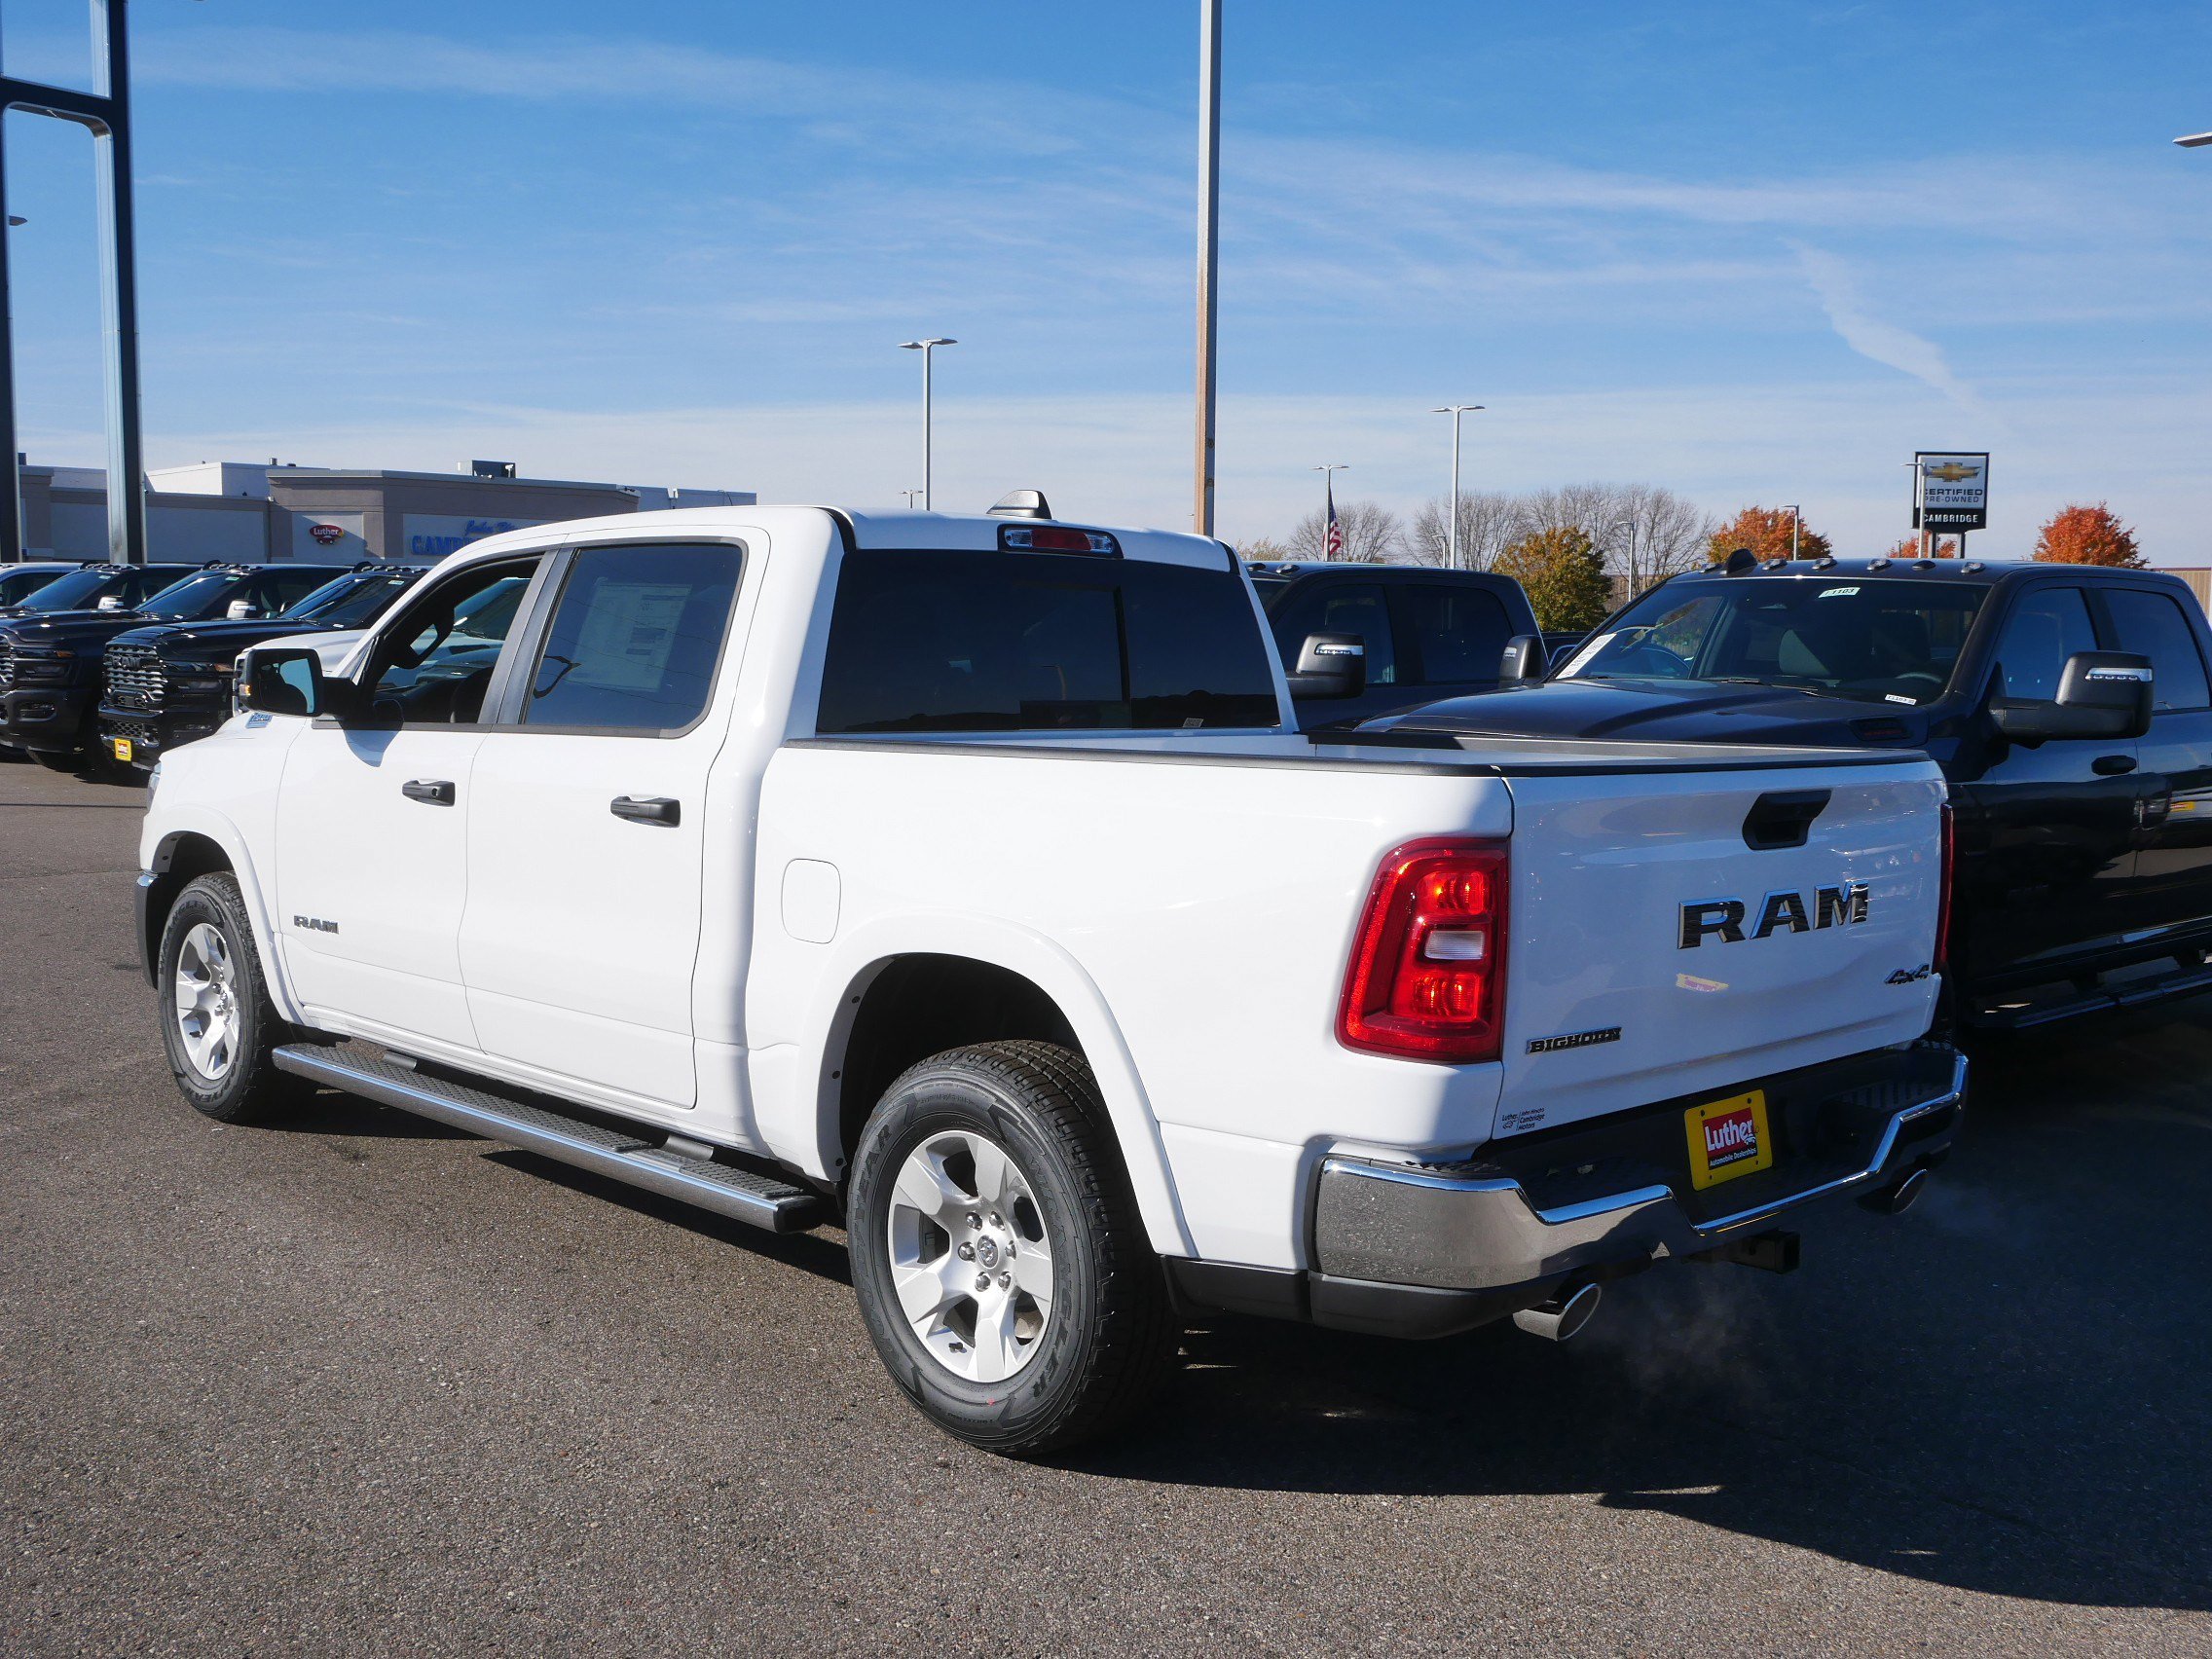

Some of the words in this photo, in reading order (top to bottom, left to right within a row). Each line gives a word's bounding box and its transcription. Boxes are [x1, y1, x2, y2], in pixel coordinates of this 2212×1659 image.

[1924, 514, 1978, 523] CAMBRIDGE
[313, 527, 339, 535] Luther
[1677, 879, 1869, 950] RAM
[293, 915, 340, 935] RAM
[1705, 1119, 1752, 1152] Luther
